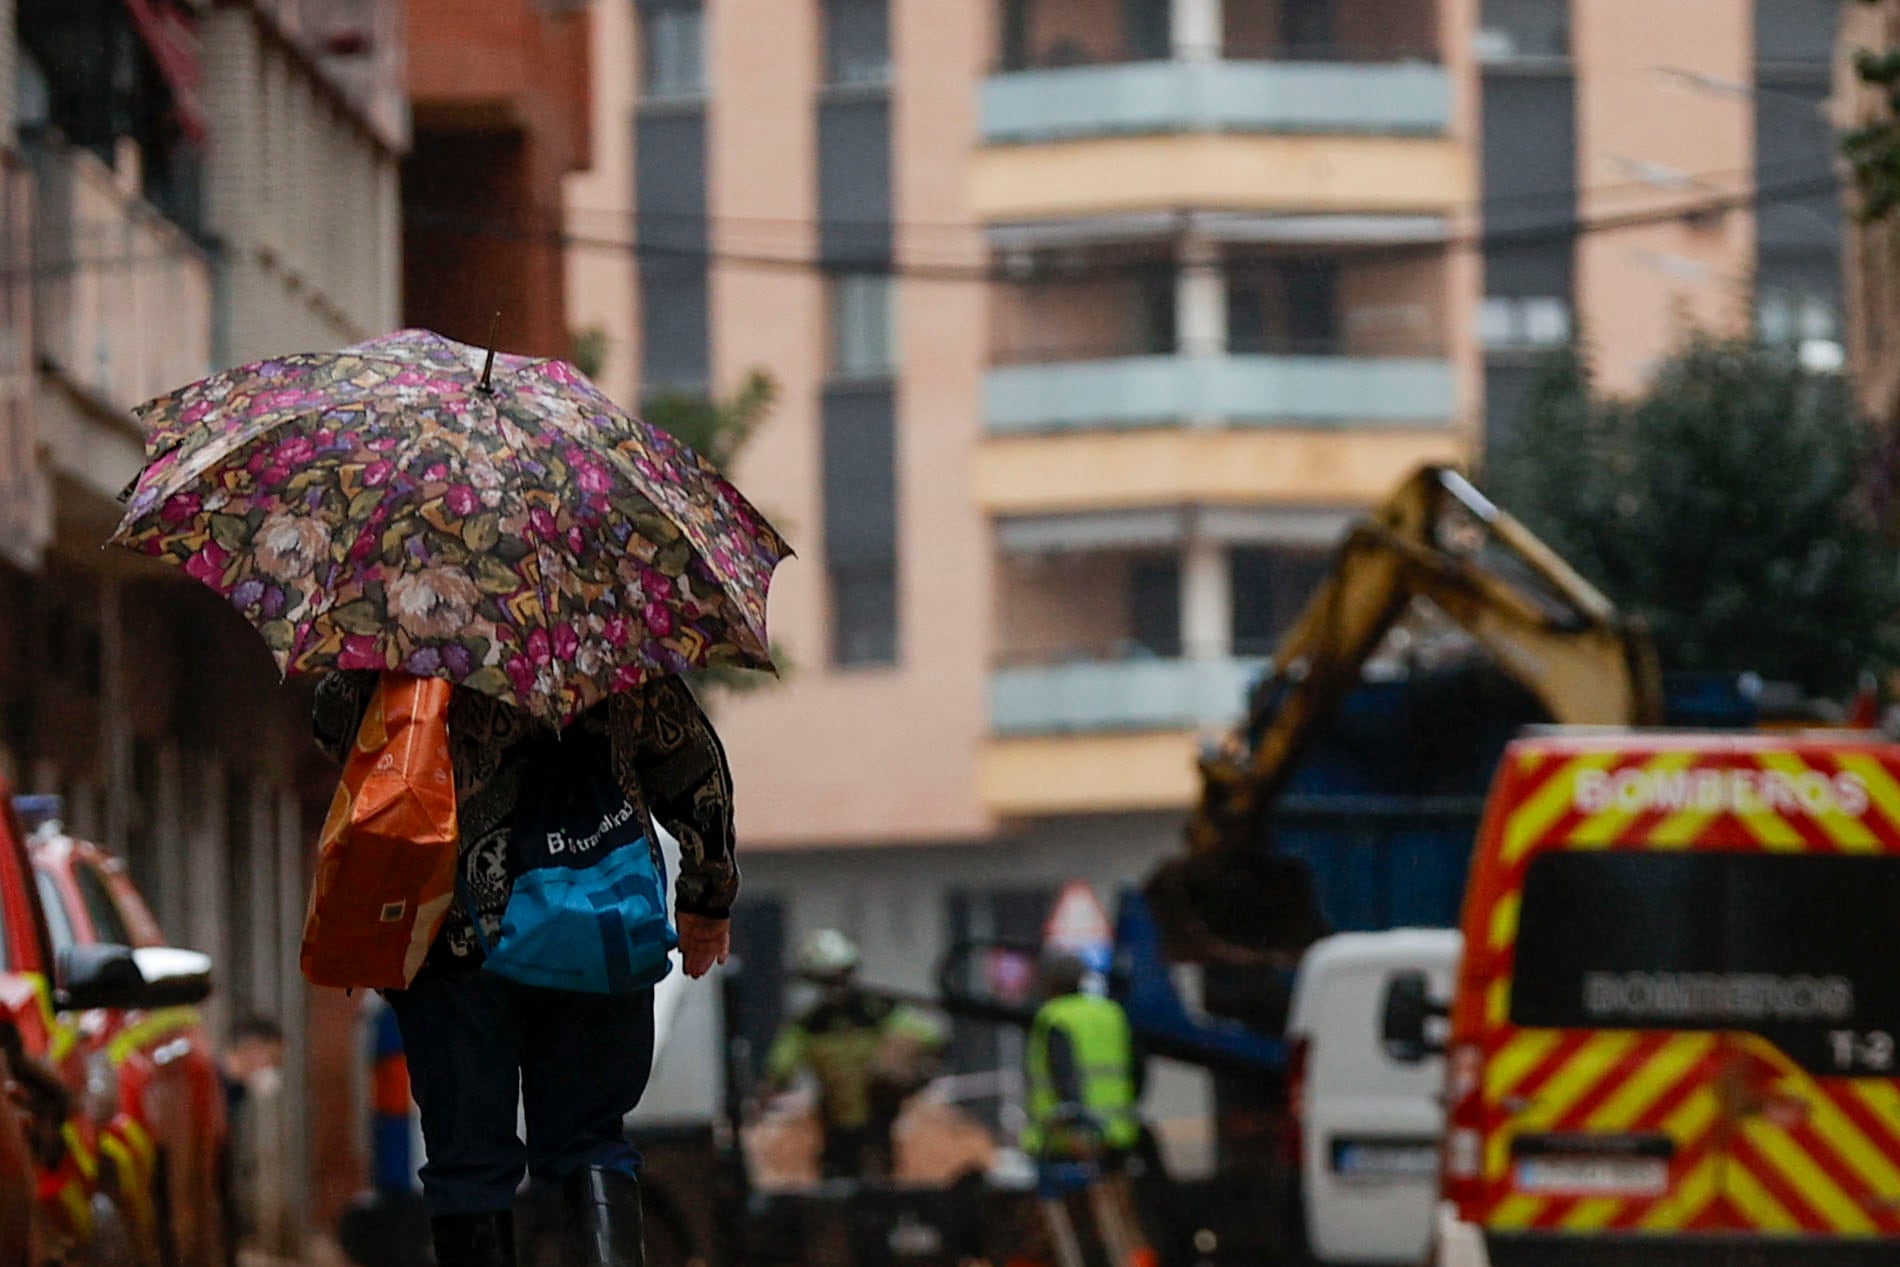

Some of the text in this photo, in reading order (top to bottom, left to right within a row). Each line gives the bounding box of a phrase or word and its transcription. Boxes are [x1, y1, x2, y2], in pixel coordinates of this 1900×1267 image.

[1573, 766, 1870, 818] BOMBEROS
[1582, 971, 1853, 1020] BOMBEROS
[1829, 1029, 1894, 1070] T-2
